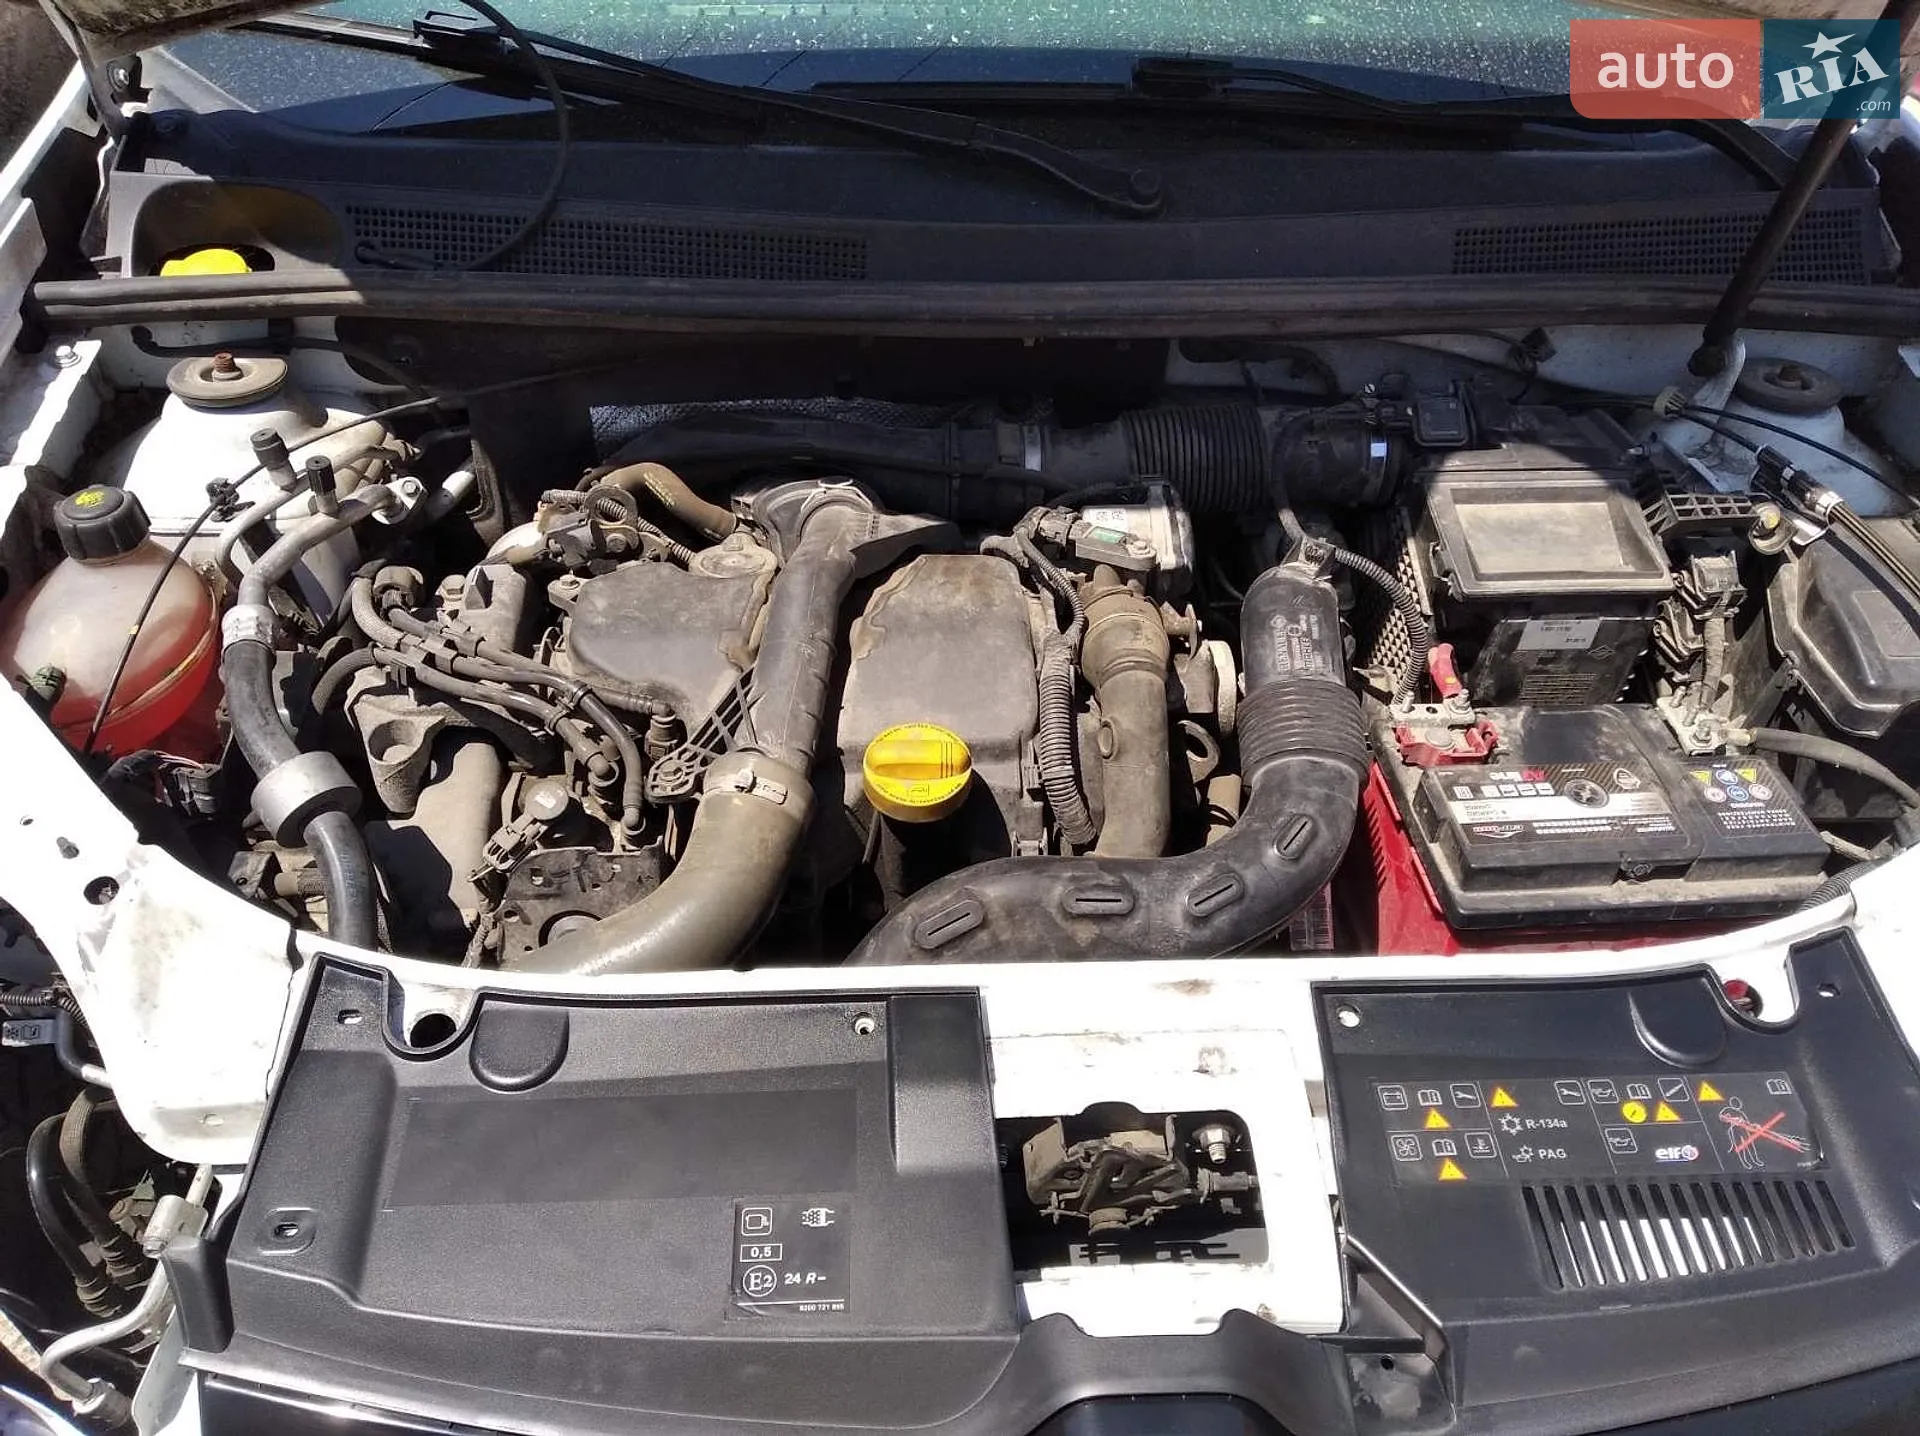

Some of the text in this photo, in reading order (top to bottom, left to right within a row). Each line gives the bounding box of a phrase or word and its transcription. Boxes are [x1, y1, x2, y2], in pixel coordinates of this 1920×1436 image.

[1525, 1118, 1568, 1129] R-134a
[1538, 1148, 1566, 1159] PAG
[750, 1246, 772, 1258] 0,5
[748, 1272, 773, 1291] E2
[784, 1273, 801, 1285] 24
